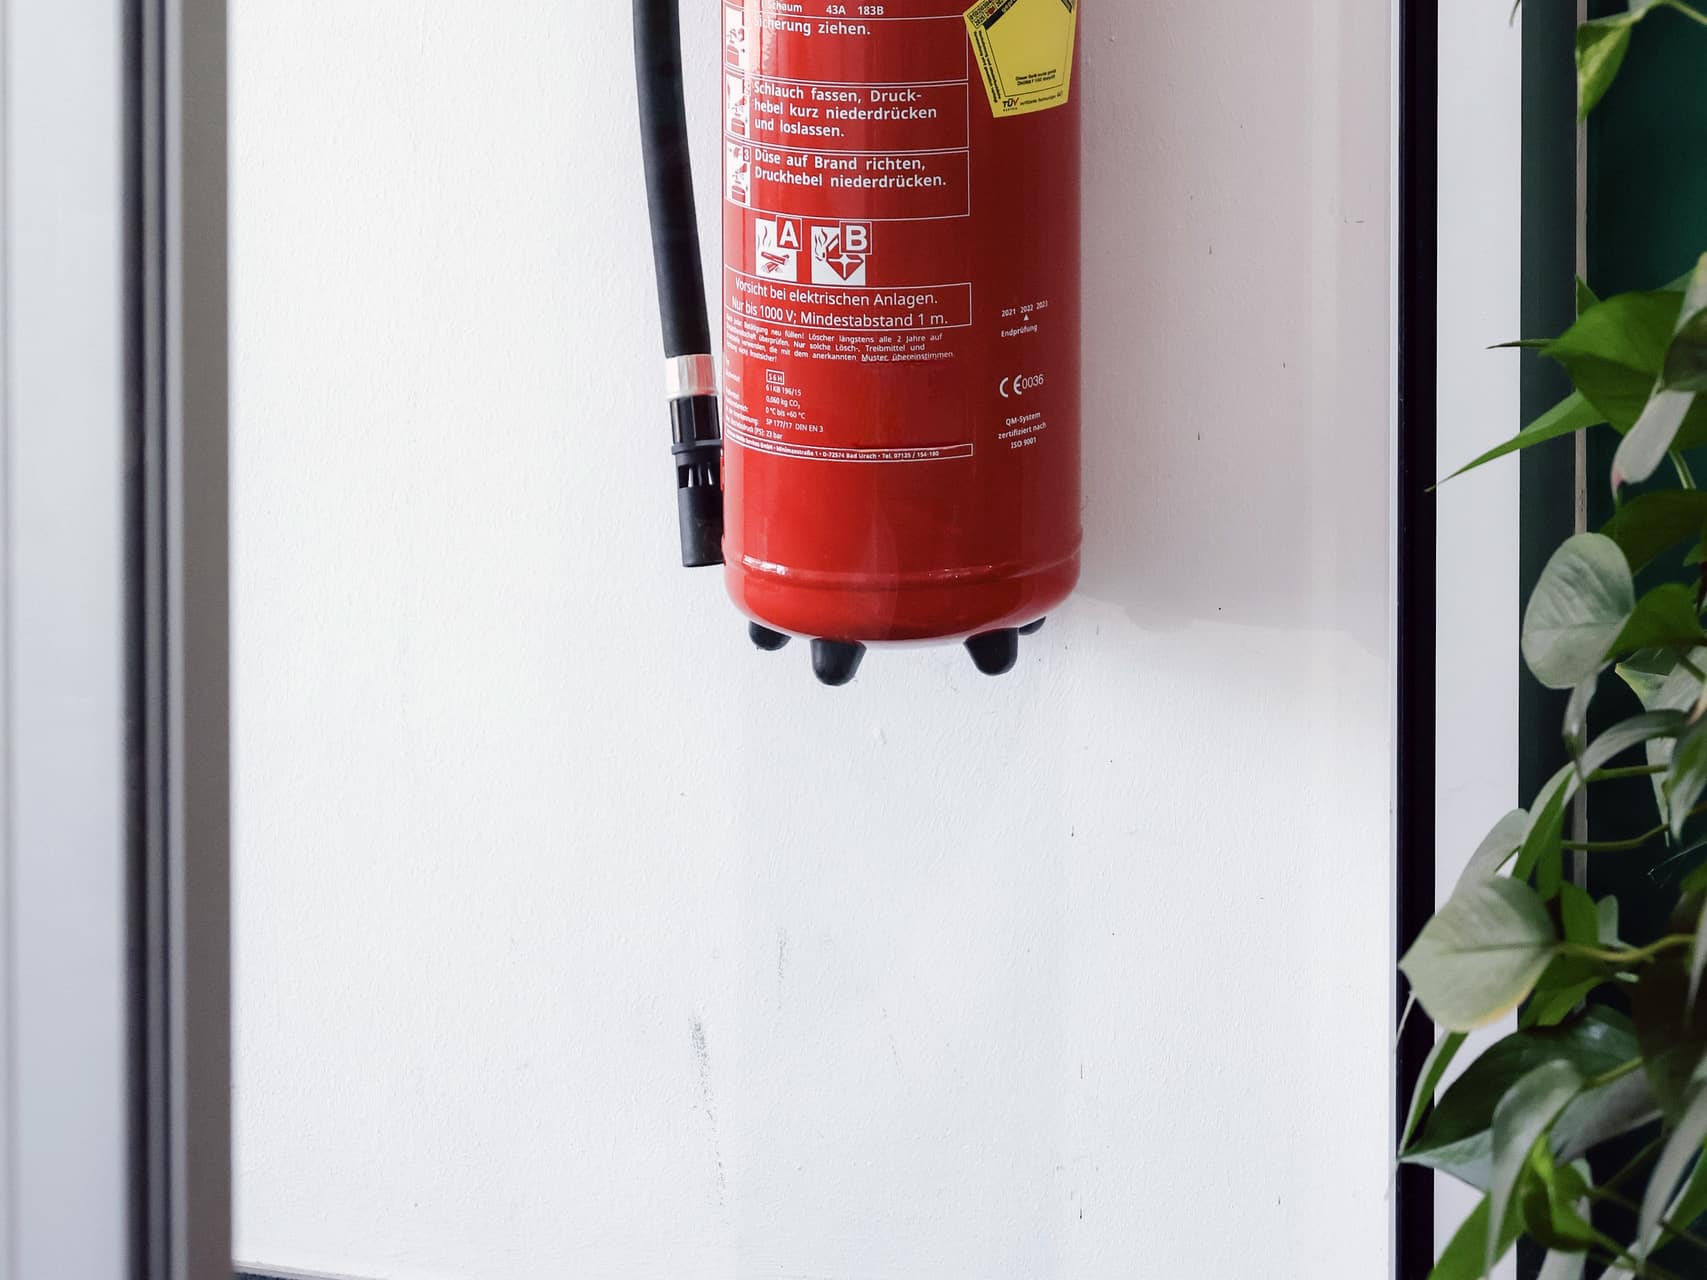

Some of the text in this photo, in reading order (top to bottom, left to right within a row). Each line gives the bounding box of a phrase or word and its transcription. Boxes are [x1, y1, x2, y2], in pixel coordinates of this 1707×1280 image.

[826, 5, 846, 15] 43A
[857, 6, 884, 16] 183B
[818, 21, 871, 35] ziehen.
[754, 81, 922, 103] Schlauch fassen, Druck-
[754, 99, 937, 120] hebel kurz niederdrücken
[755, 118, 845, 137] und loslassen.
[755, 148, 926, 171] Düse auf Brand richten,
[755, 166, 947, 188] Druckhebel niederdrücken.
[779, 220, 799, 247] A
[845, 225, 868, 251] B
[736, 276, 938, 308] Vorsicht bei elektrischen Anlagen.
[732, 295, 745, 313] Nur
[745, 299, 758, 316] bis
[760, 304, 783, 321] 1000
[786, 309, 797, 325] V;
[800, 311, 913, 328] Mindestabstand
[918, 313, 924, 325] 1
[930, 314, 948, 325] m.
[808, 333, 835, 342] Löscher
[878, 335, 892, 343] alle
[906, 334, 926, 343] Jahre
[930, 332, 943, 341] auf
[1001, 323, 1038, 338] Endprüfung
[793, 341, 806, 349] Nur
[865, 344, 906, 352] Treibmittel
[812, 352, 857, 361] anerkannten
[1021, 373, 1044, 389] 0036
[1005, 411, 1041, 427] QM-System
[1010, 436, 1037, 449] ISO 9001
